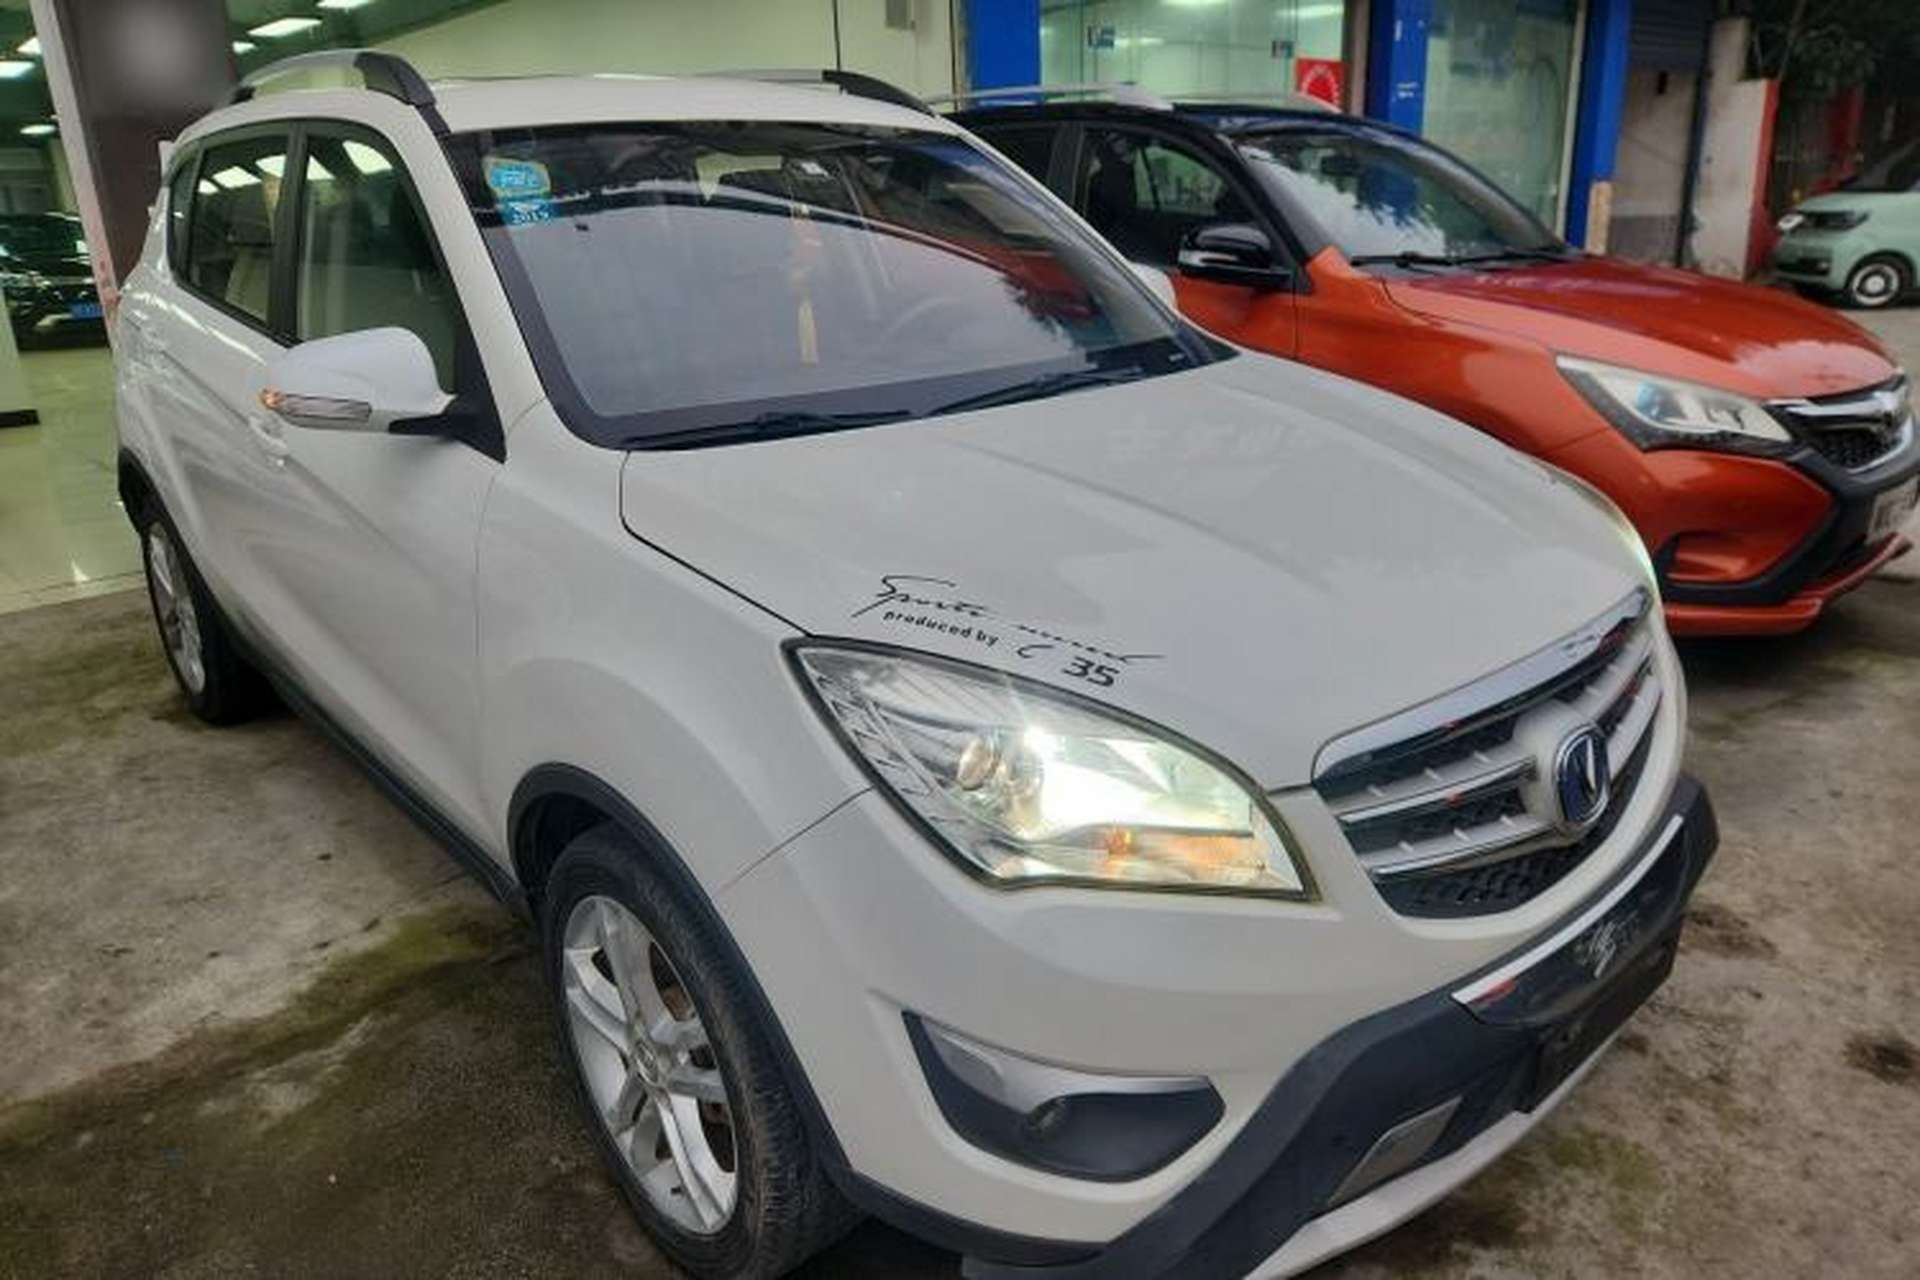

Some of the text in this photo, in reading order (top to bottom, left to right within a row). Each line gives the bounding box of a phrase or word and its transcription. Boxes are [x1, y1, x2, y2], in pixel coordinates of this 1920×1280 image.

[883, 611, 972, 639] produced
[976, 629, 999, 648] by
[1061, 655, 1120, 688] 35
